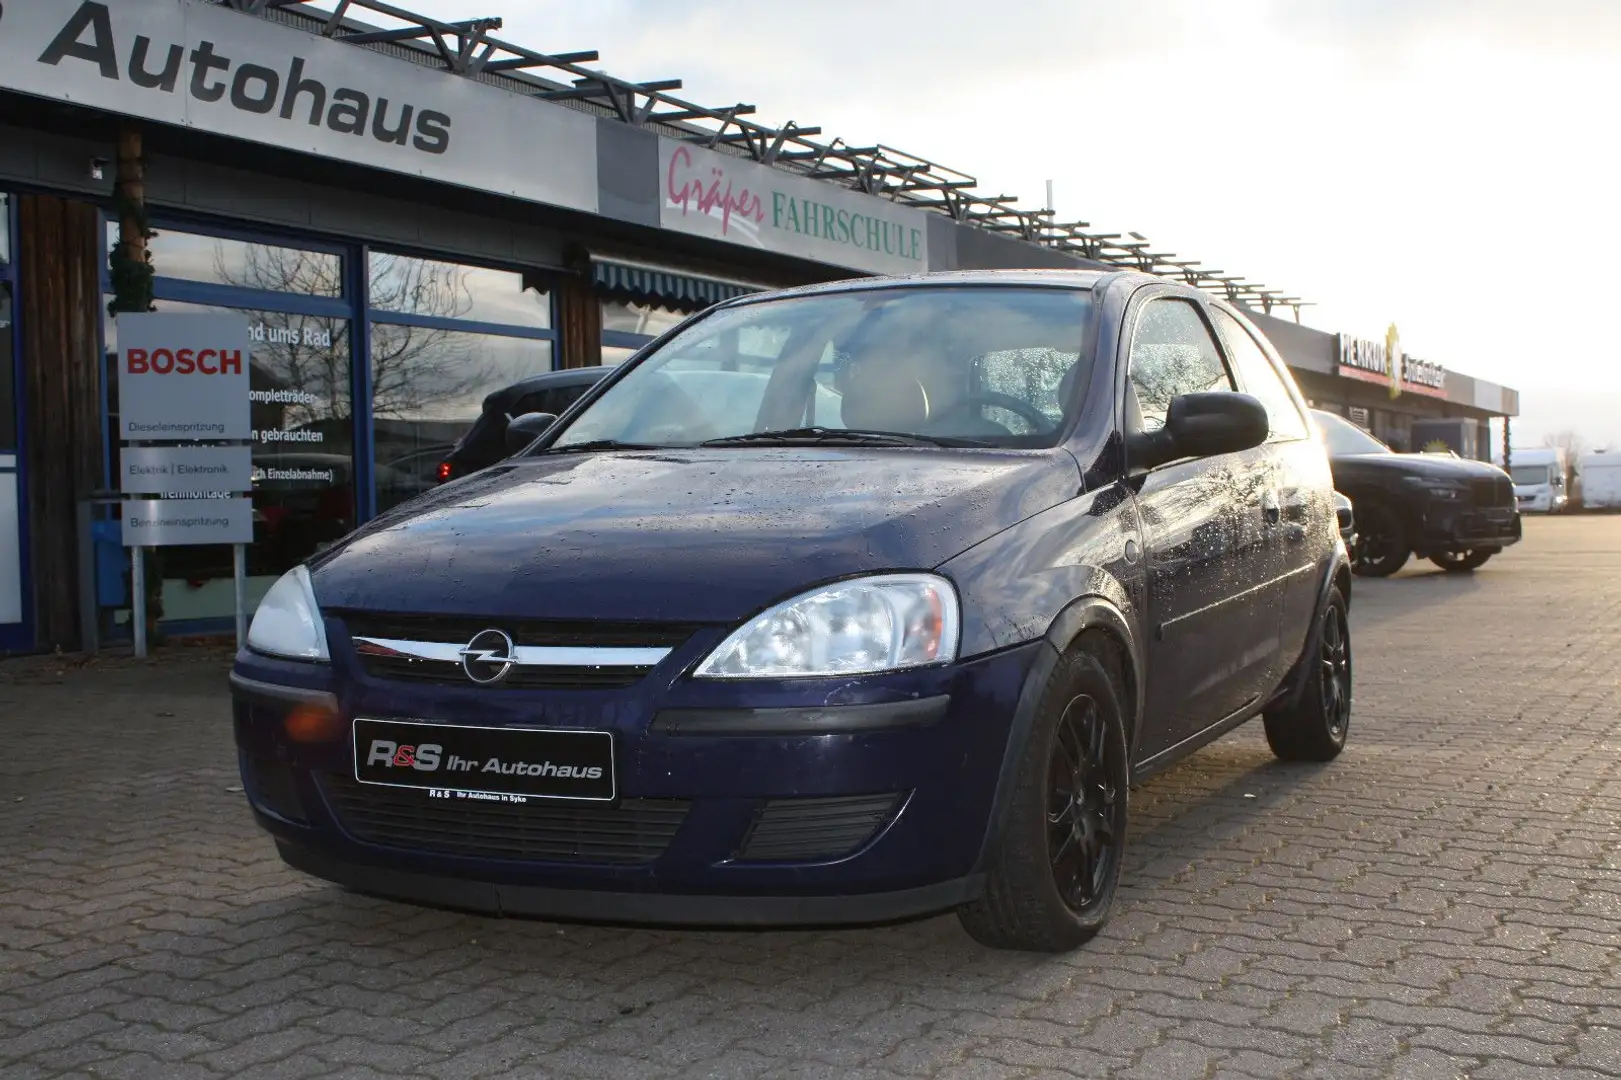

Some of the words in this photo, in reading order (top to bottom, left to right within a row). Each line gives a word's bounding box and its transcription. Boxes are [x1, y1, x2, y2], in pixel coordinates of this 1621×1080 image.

[37, 0, 452, 155] Autohaus
[667, 145, 764, 236] Gräper
[771, 190, 922, 262] FAHRSCHULE
[268, 327, 300, 345] ums
[303, 327, 332, 348] Rad
[127, 348, 242, 375] BOSCH
[128, 421, 225, 434] Dieseleinspritzung
[261, 427, 323, 444] gebrauchten
[129, 463, 168, 475] Elektrik
[177, 462, 229, 475] Elektronik
[267, 468, 333, 482] Einzelabnahme)
[130, 516, 229, 529] Benzineinspritzung
[366, 739, 443, 772] R&S
[446, 754, 479, 773] Ihr
[481, 757, 603, 780] Autohaus
[429, 789, 436, 798] R
[443, 790, 450, 799] S
[467, 792, 501, 801] Autohaus
[501, 794, 509, 802] in
[509, 795, 527, 804] Syke
